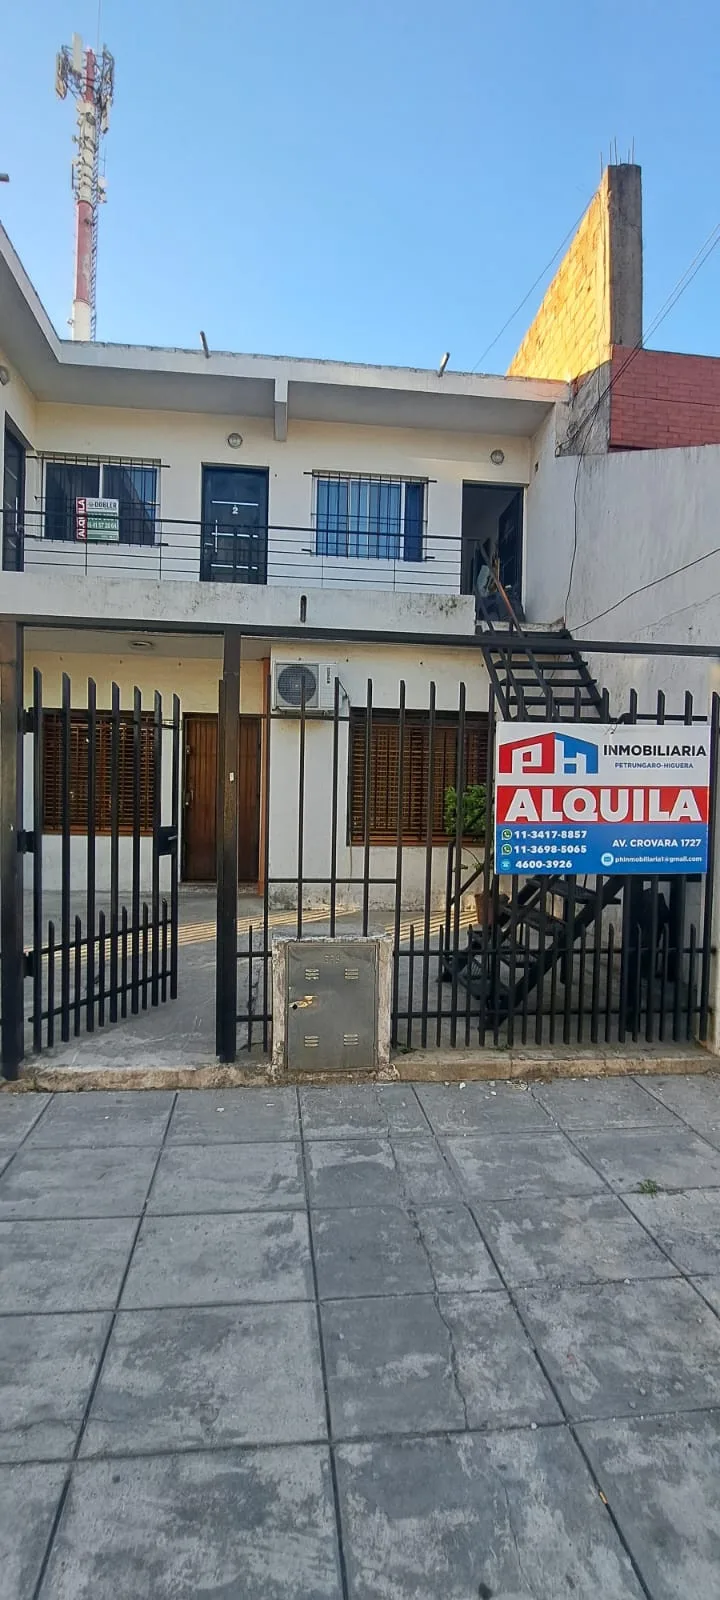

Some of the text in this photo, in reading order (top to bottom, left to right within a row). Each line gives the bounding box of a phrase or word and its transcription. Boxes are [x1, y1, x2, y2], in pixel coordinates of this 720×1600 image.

[232, 506, 239, 515] 2
[603, 744, 707, 757] INMOBILIARIA
[504, 788, 703, 823] ALQUILA
[514, 830, 588, 839] 11-3417-8857
[612, 838, 702, 848] AV. CROVARA 1727
[514, 845, 587, 854] 11-3698-5065
[515, 860, 573, 869] 4600-3926
